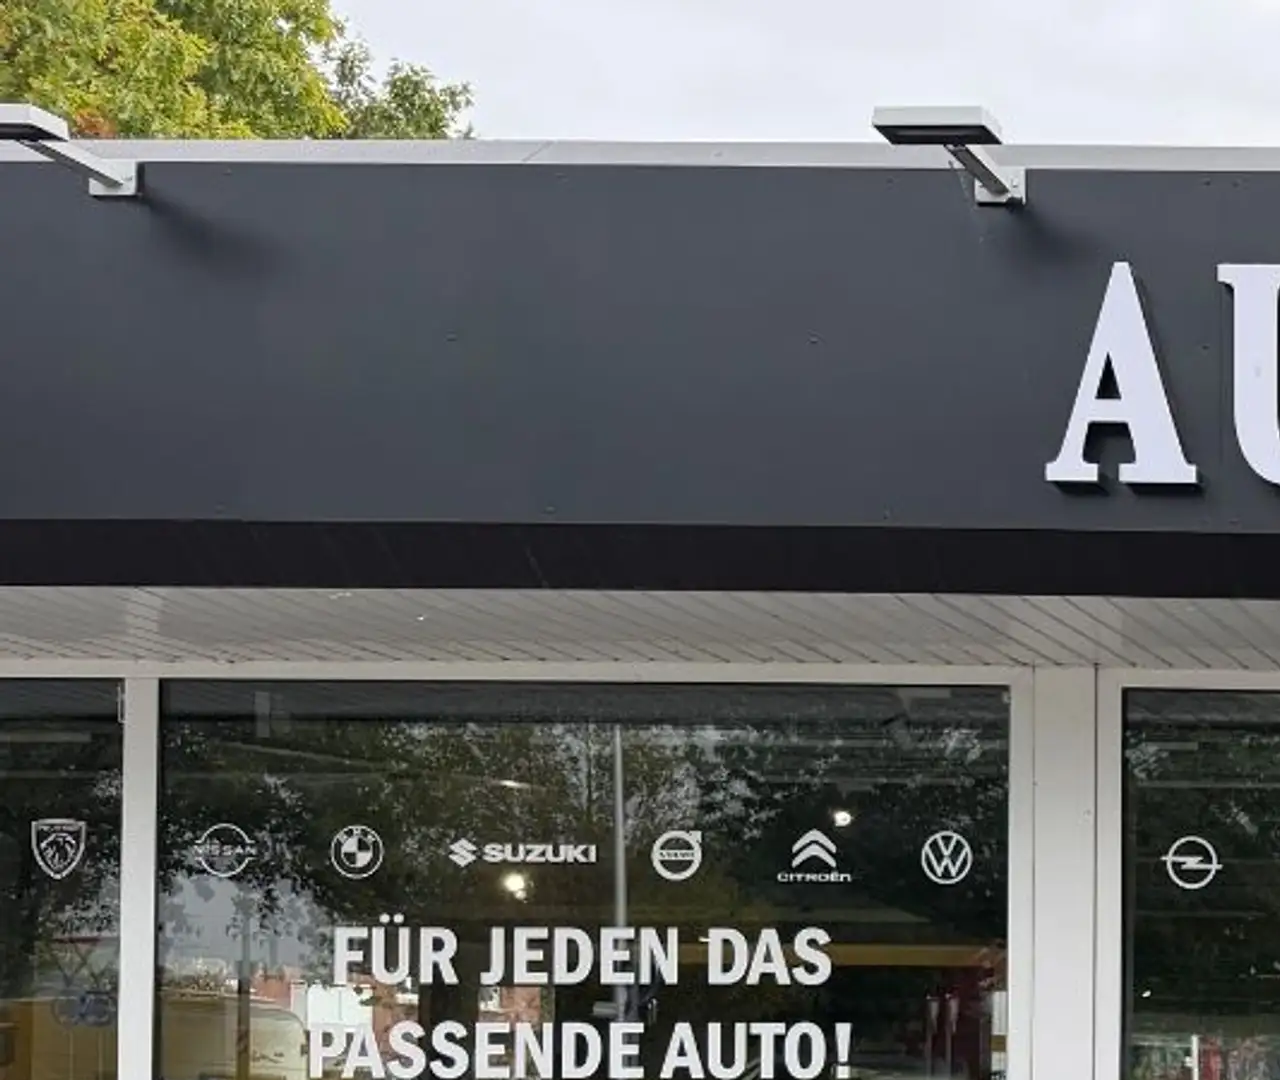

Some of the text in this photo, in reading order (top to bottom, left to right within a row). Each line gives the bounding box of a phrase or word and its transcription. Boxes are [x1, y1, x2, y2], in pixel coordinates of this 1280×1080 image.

[482, 843, 597, 865] SUZUKI
[334, 913, 832, 987] FÜR JEDEN DAS
[309, 1020, 853, 1080] PASSENDE AUTO!
